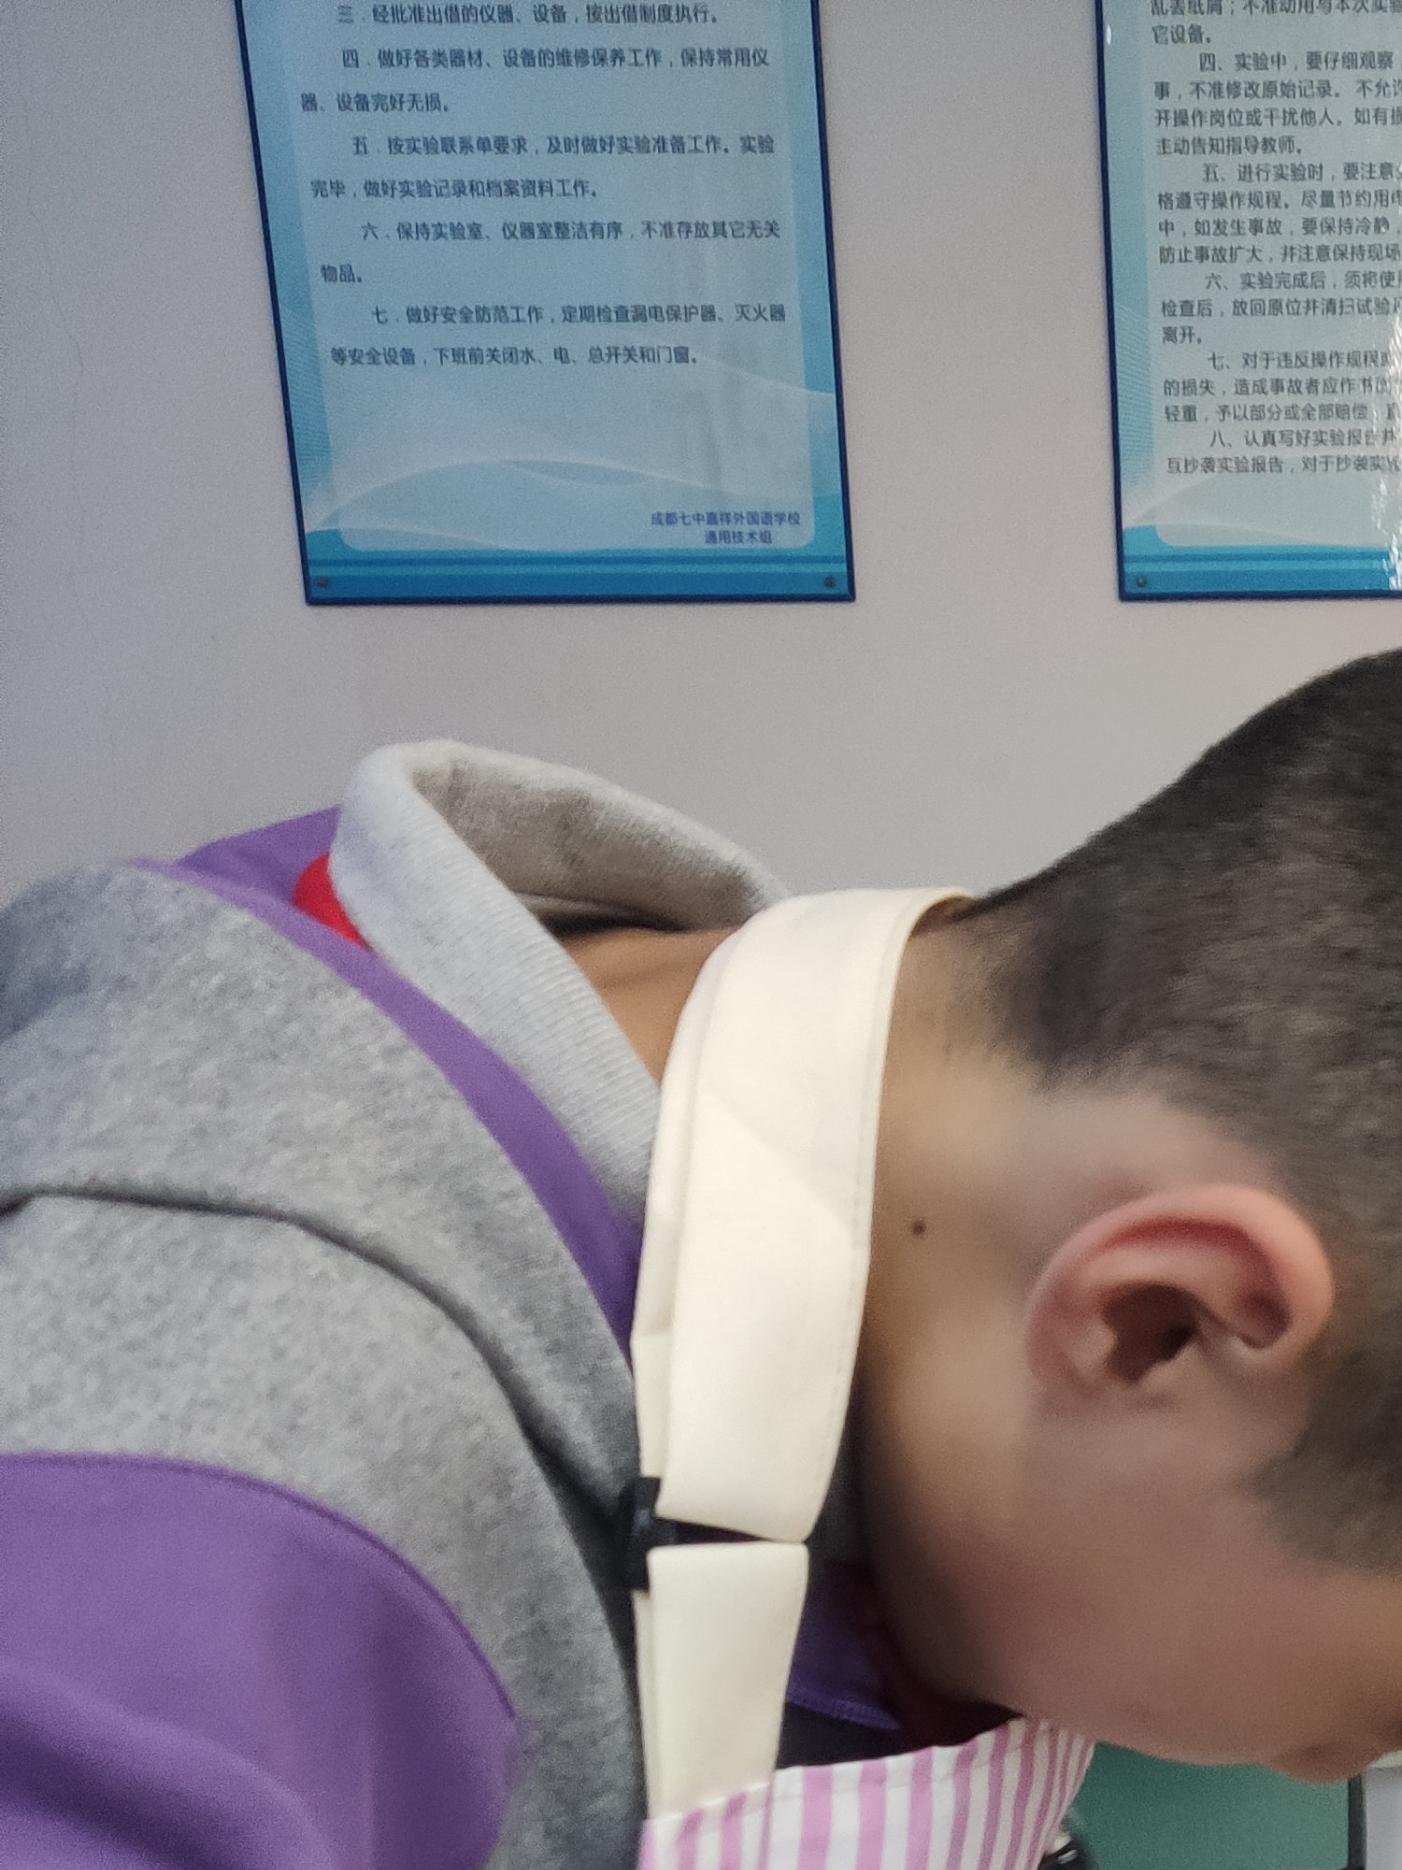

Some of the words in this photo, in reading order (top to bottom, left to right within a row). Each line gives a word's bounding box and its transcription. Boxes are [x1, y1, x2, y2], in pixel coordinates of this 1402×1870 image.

[1152, 24, 1212, 45] 它设备。
[301, 92, 448, 113] 器、设备完好无损。
[1156, 135, 1303, 156] 主动告知指导教师。
[320, 263, 363, 284] 物品。
[1162, 325, 1202, 345] 离开。
[651, 510, 801, 527] 成都七中嘉祥外国语学校
[704, 530, 773, 545] 通用技术组
